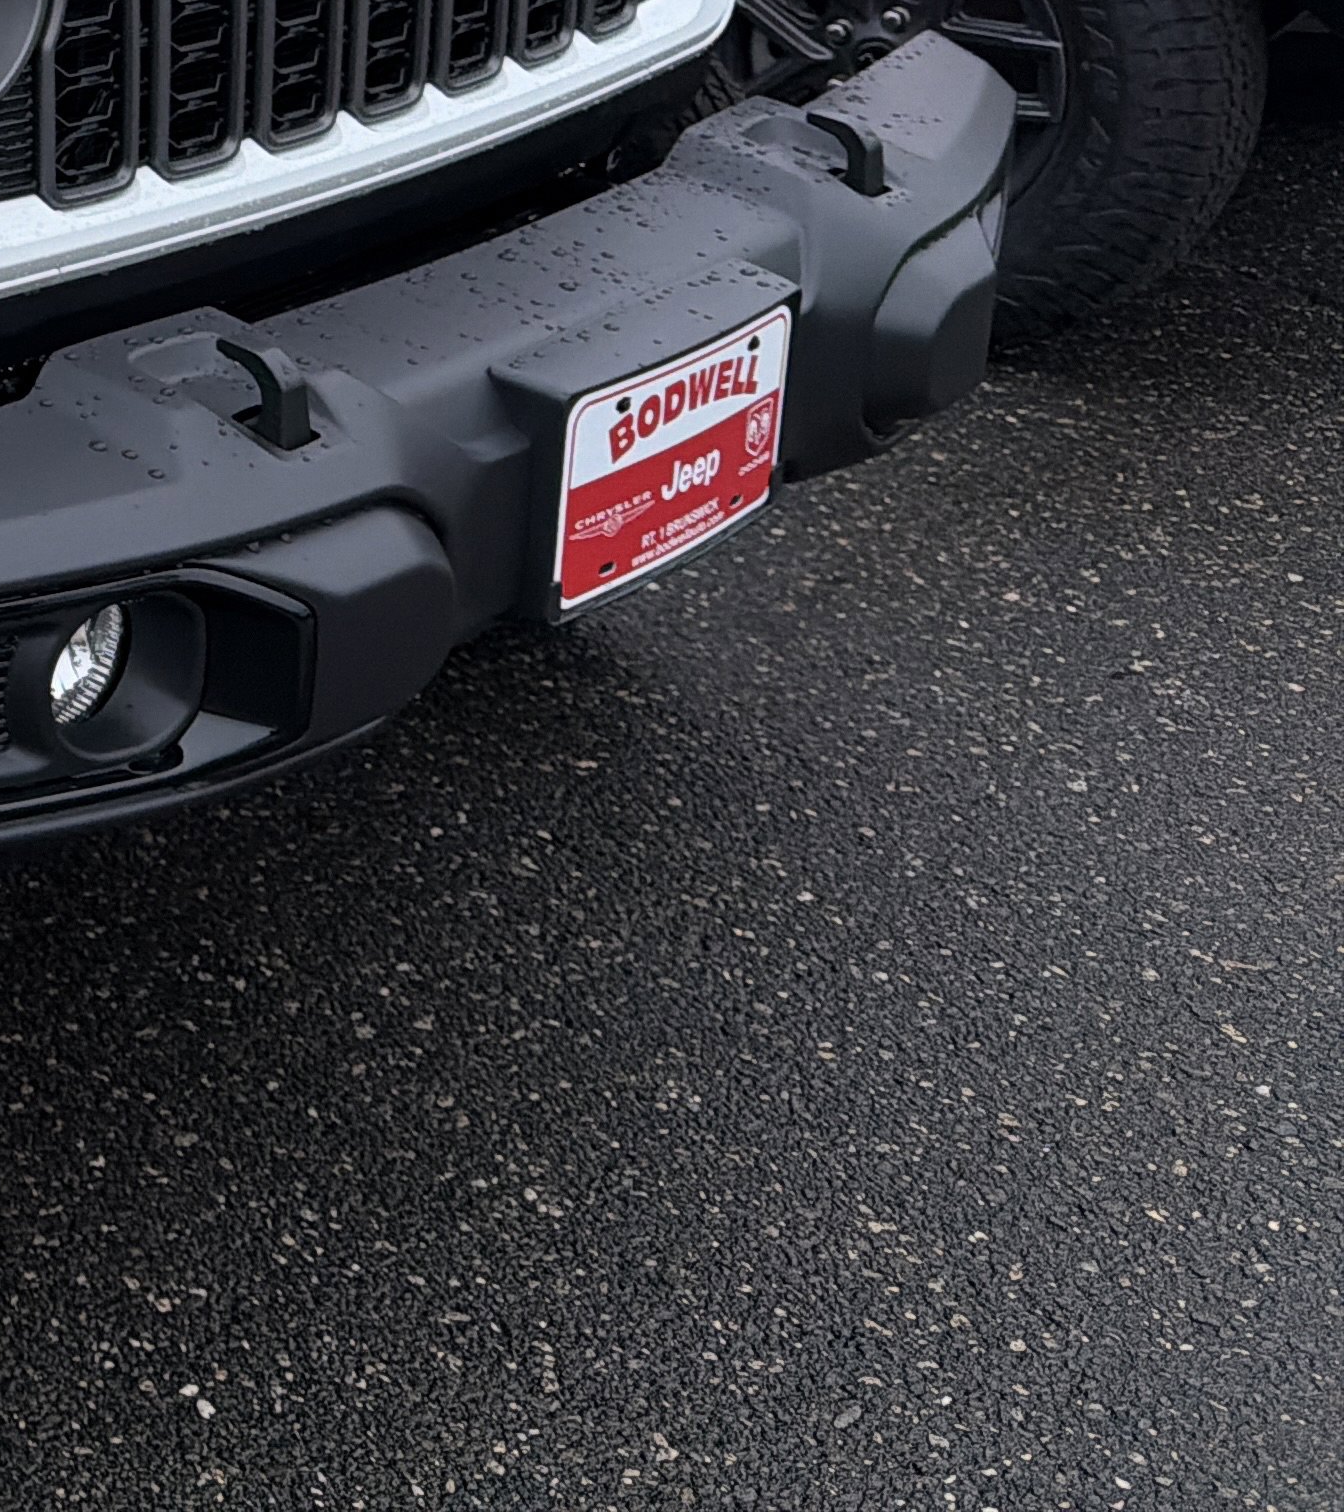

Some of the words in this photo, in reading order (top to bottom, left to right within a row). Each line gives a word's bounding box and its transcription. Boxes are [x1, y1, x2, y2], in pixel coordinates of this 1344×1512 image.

[608, 355, 759, 465] BODWELL
[661, 449, 721, 501] Jeep
[574, 490, 653, 531] CHRYSLER
